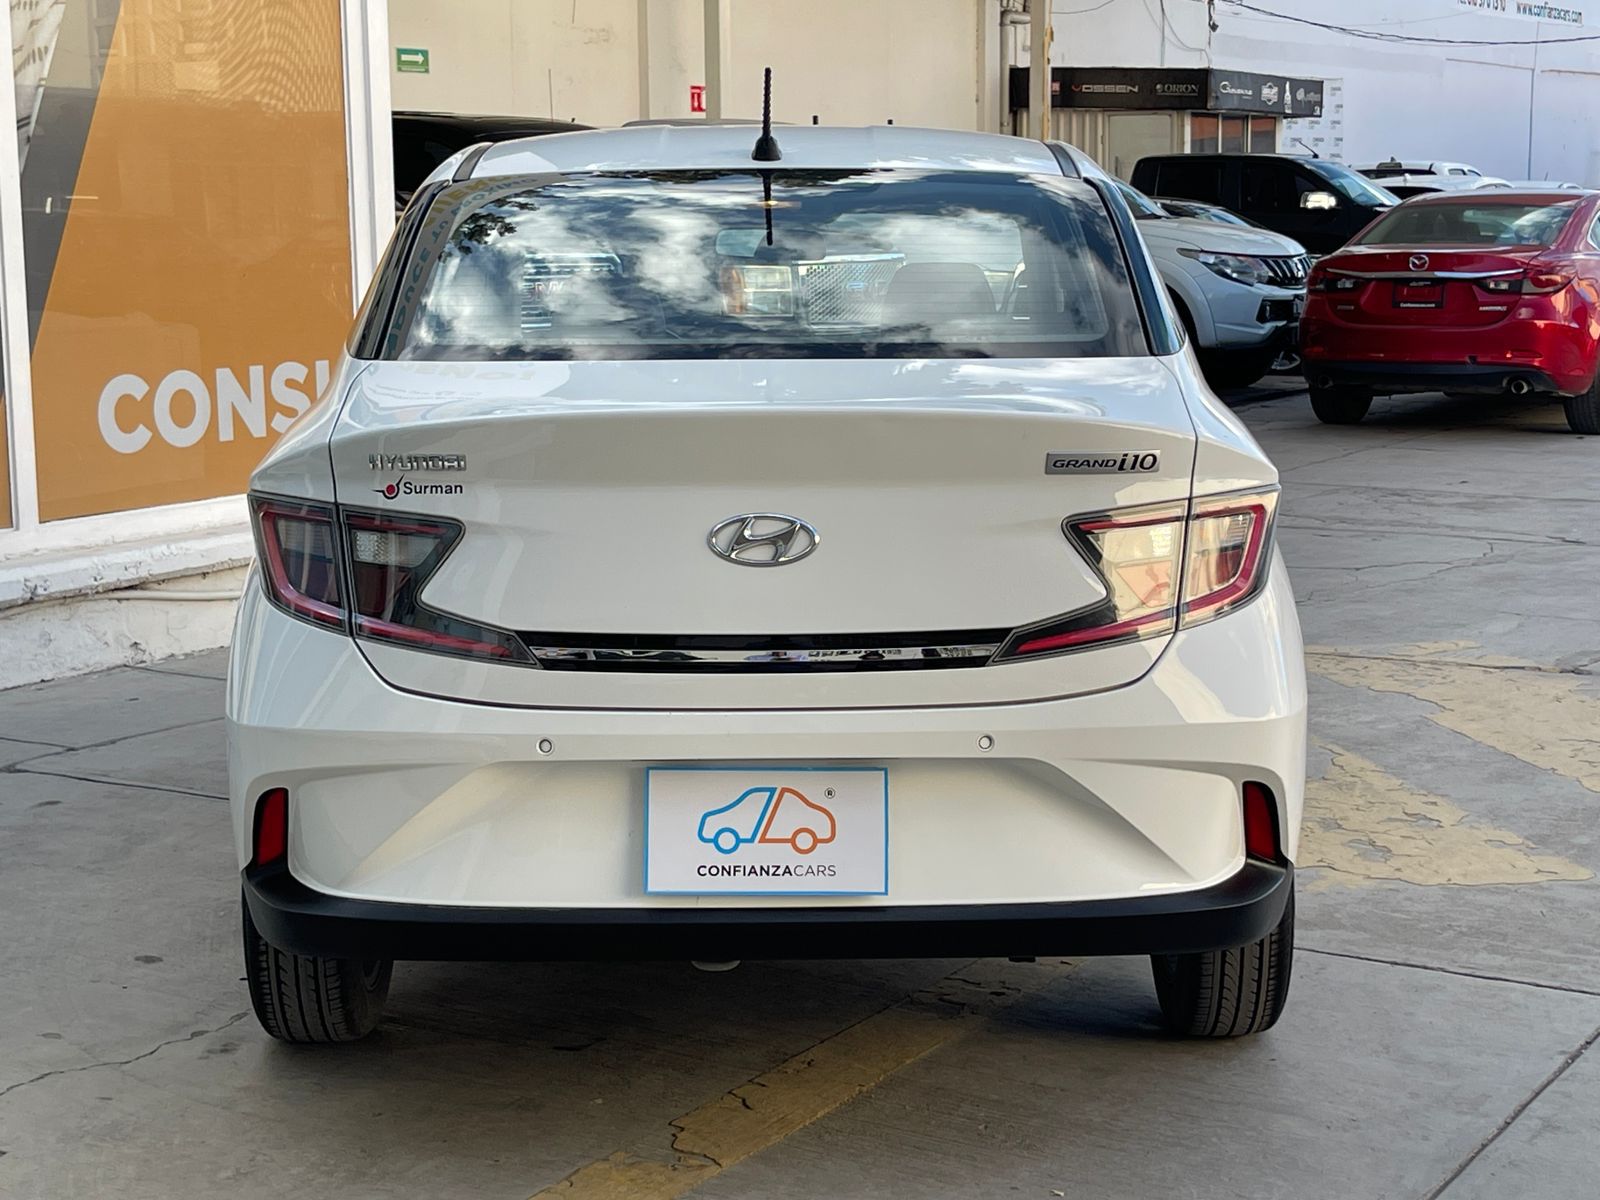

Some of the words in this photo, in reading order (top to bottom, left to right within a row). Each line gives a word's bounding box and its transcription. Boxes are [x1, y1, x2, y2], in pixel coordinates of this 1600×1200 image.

[1072, 84, 1138, 93] VOSSEN
[1164, 83, 1199, 93] ORION
[368, 453, 467, 471] HYUNDAI
[1052, 459, 1117, 468] GRAND
[1117, 453, 1157, 471] i10
[403, 481, 463, 494] Surman
[697, 864, 836, 877] CONFIANZACARS
